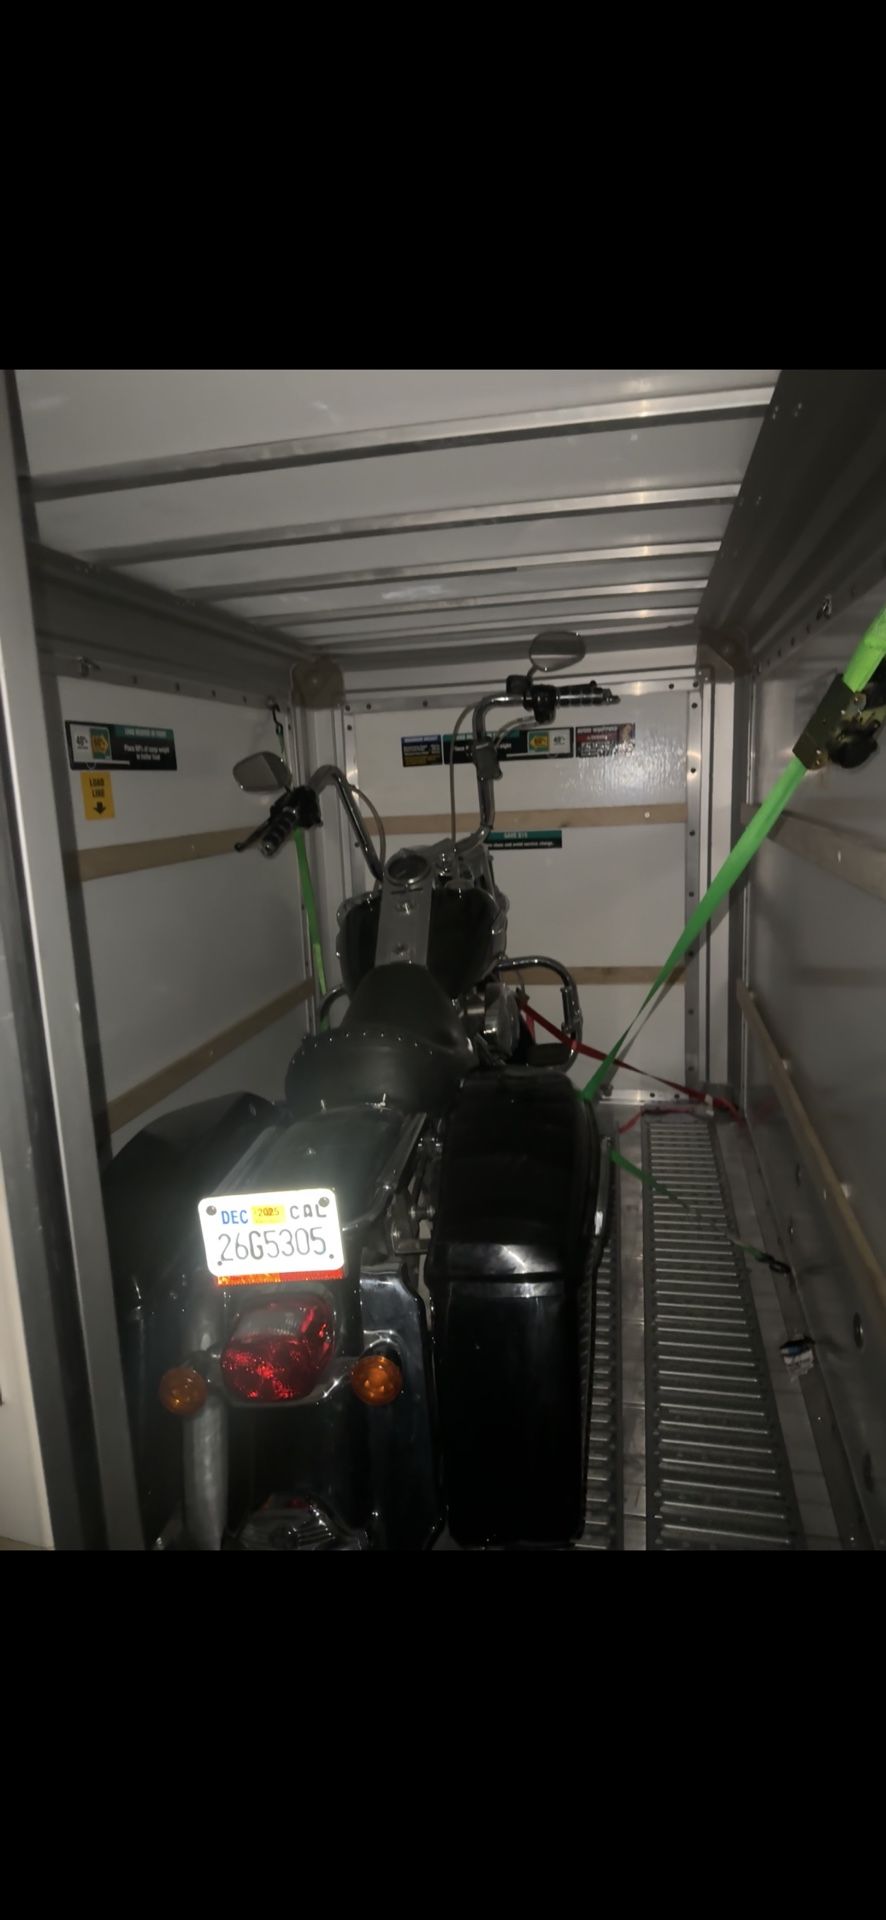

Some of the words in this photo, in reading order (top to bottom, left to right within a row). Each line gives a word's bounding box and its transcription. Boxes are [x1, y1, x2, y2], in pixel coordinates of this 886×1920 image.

[89, 777, 105, 787] LOAD
[91, 788, 105, 798] LINE
[221, 1209, 248, 1225] DEC
[289, 1203, 327, 1220] CAL
[217, 1226, 327, 1262] 26G5305
